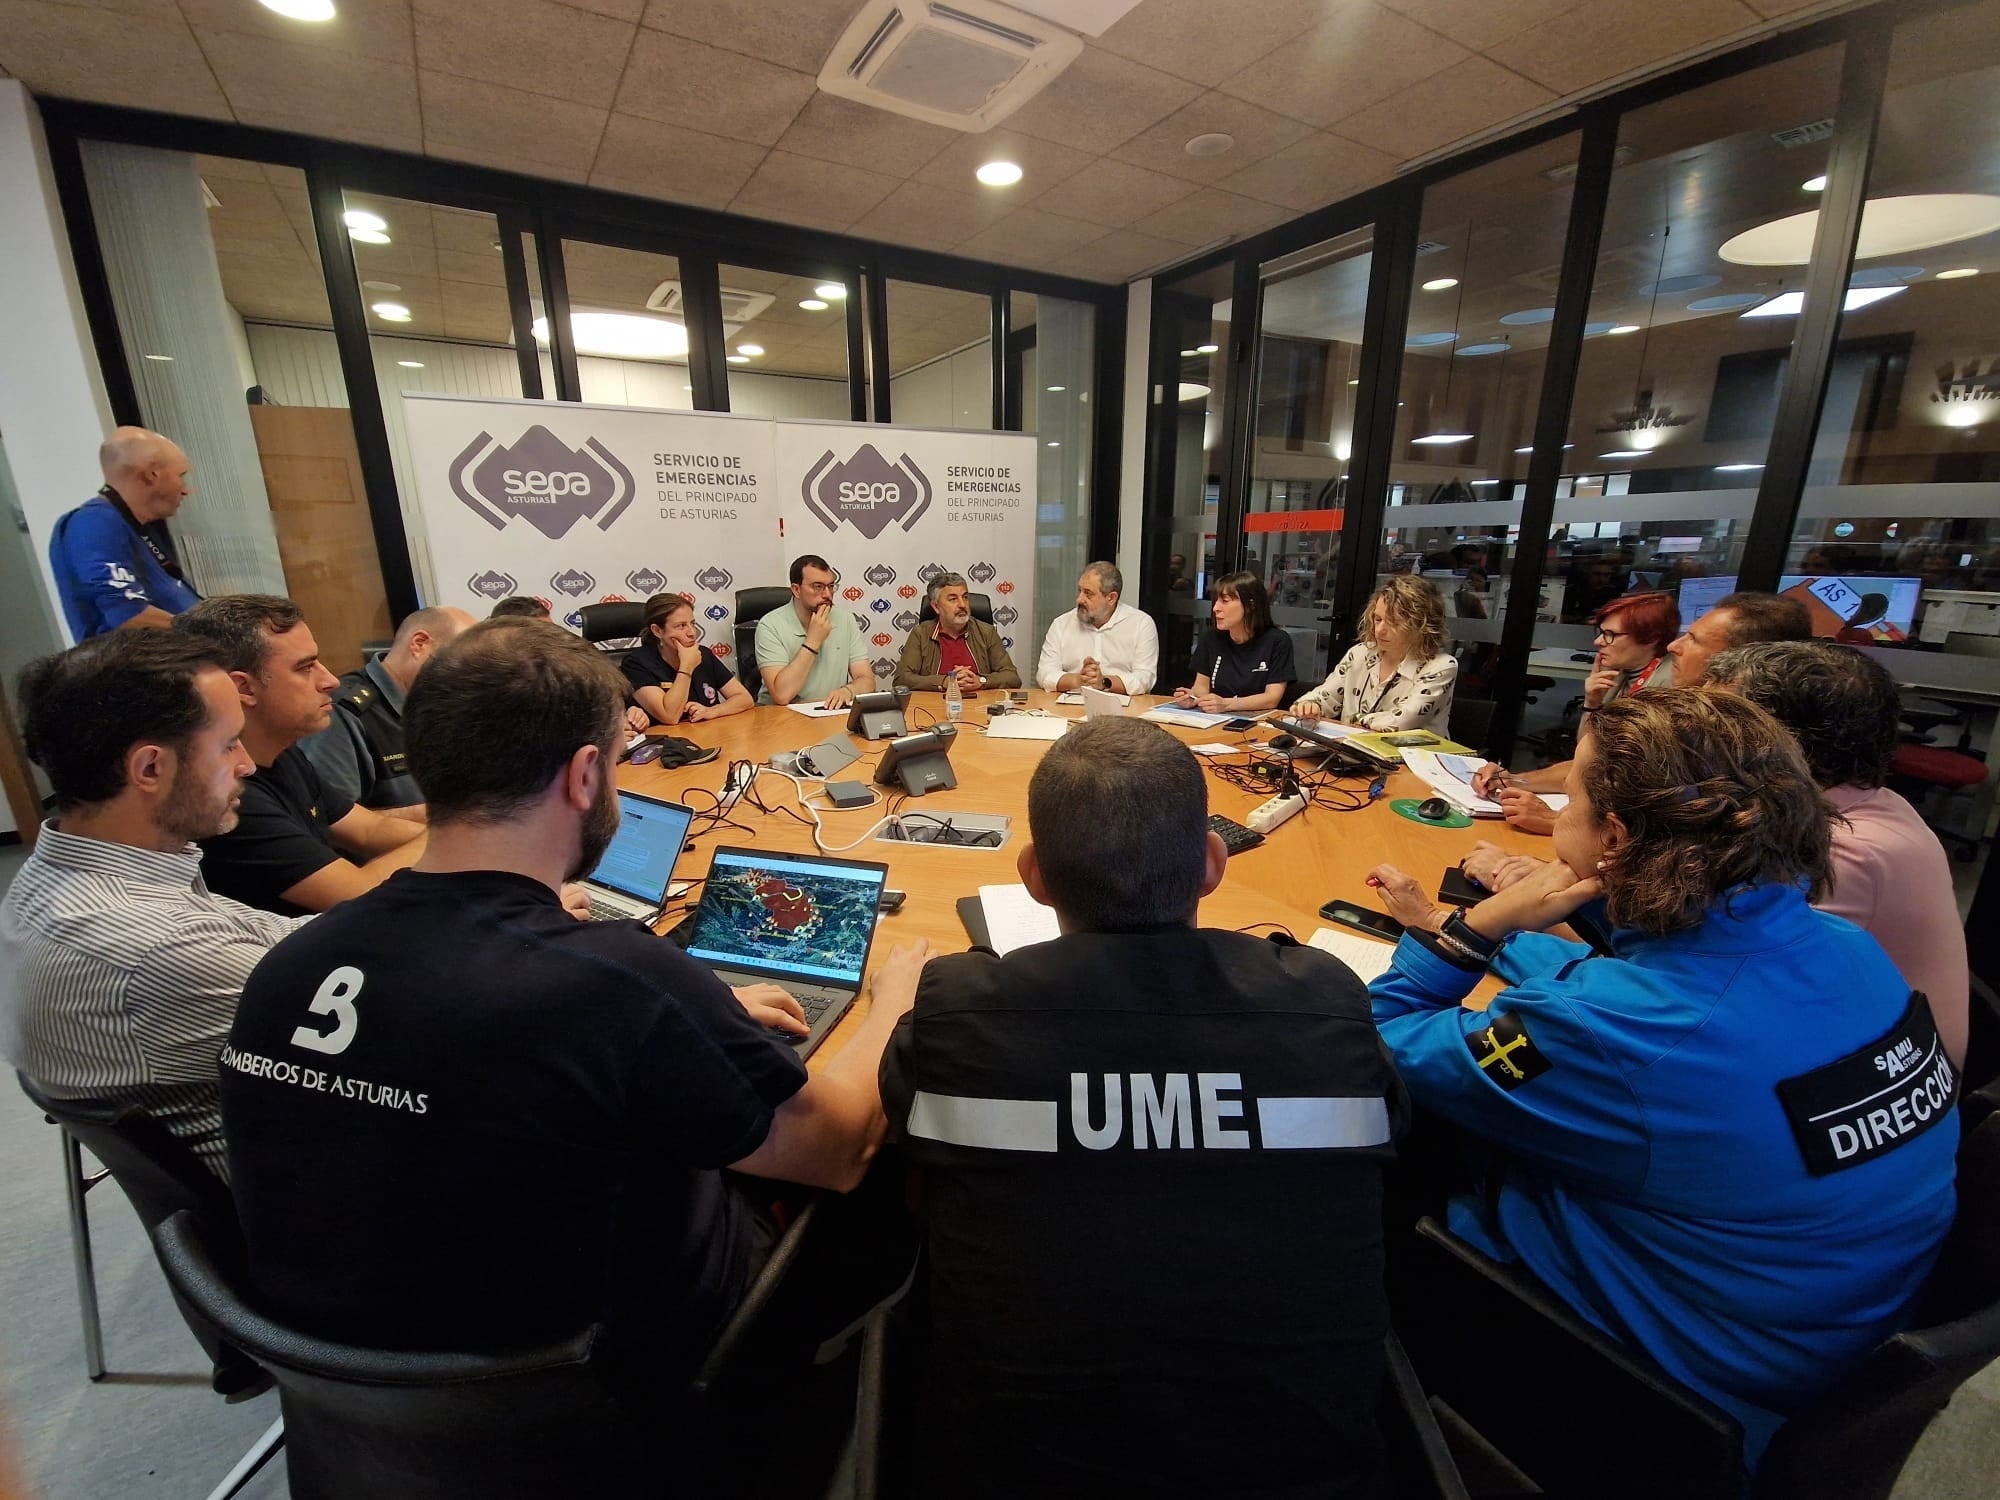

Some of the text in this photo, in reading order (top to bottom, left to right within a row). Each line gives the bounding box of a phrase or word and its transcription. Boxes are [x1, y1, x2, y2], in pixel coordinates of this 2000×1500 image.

[654, 453, 741, 468] SERVICIO DE
[656, 471, 757, 486] EMERGENCIAS
[947, 466, 1011, 478] SERVICIO DE
[503, 470, 591, 504] sepa
[947, 481, 1021, 493] EMERGENCIAS
[508, 496, 551, 504] ASTURIAS
[658, 491, 757, 503] DEL PRINCIPADO
[839, 481, 900, 509] sepa
[947, 497, 1020, 508] DEL PRINCIPADO
[660, 508, 738, 520] DE ASTURIAS
[947, 513, 1004, 522] DE ASTURIAS
[481, 580, 506, 591] sepa
[1817, 582, 1847, 602] AS
[1874, 1036, 1913, 1078] SAMU
[219, 1042, 429, 1114] BOMBEROS DE ASTURIAS
[1070, 1072, 1250, 1151] UME
